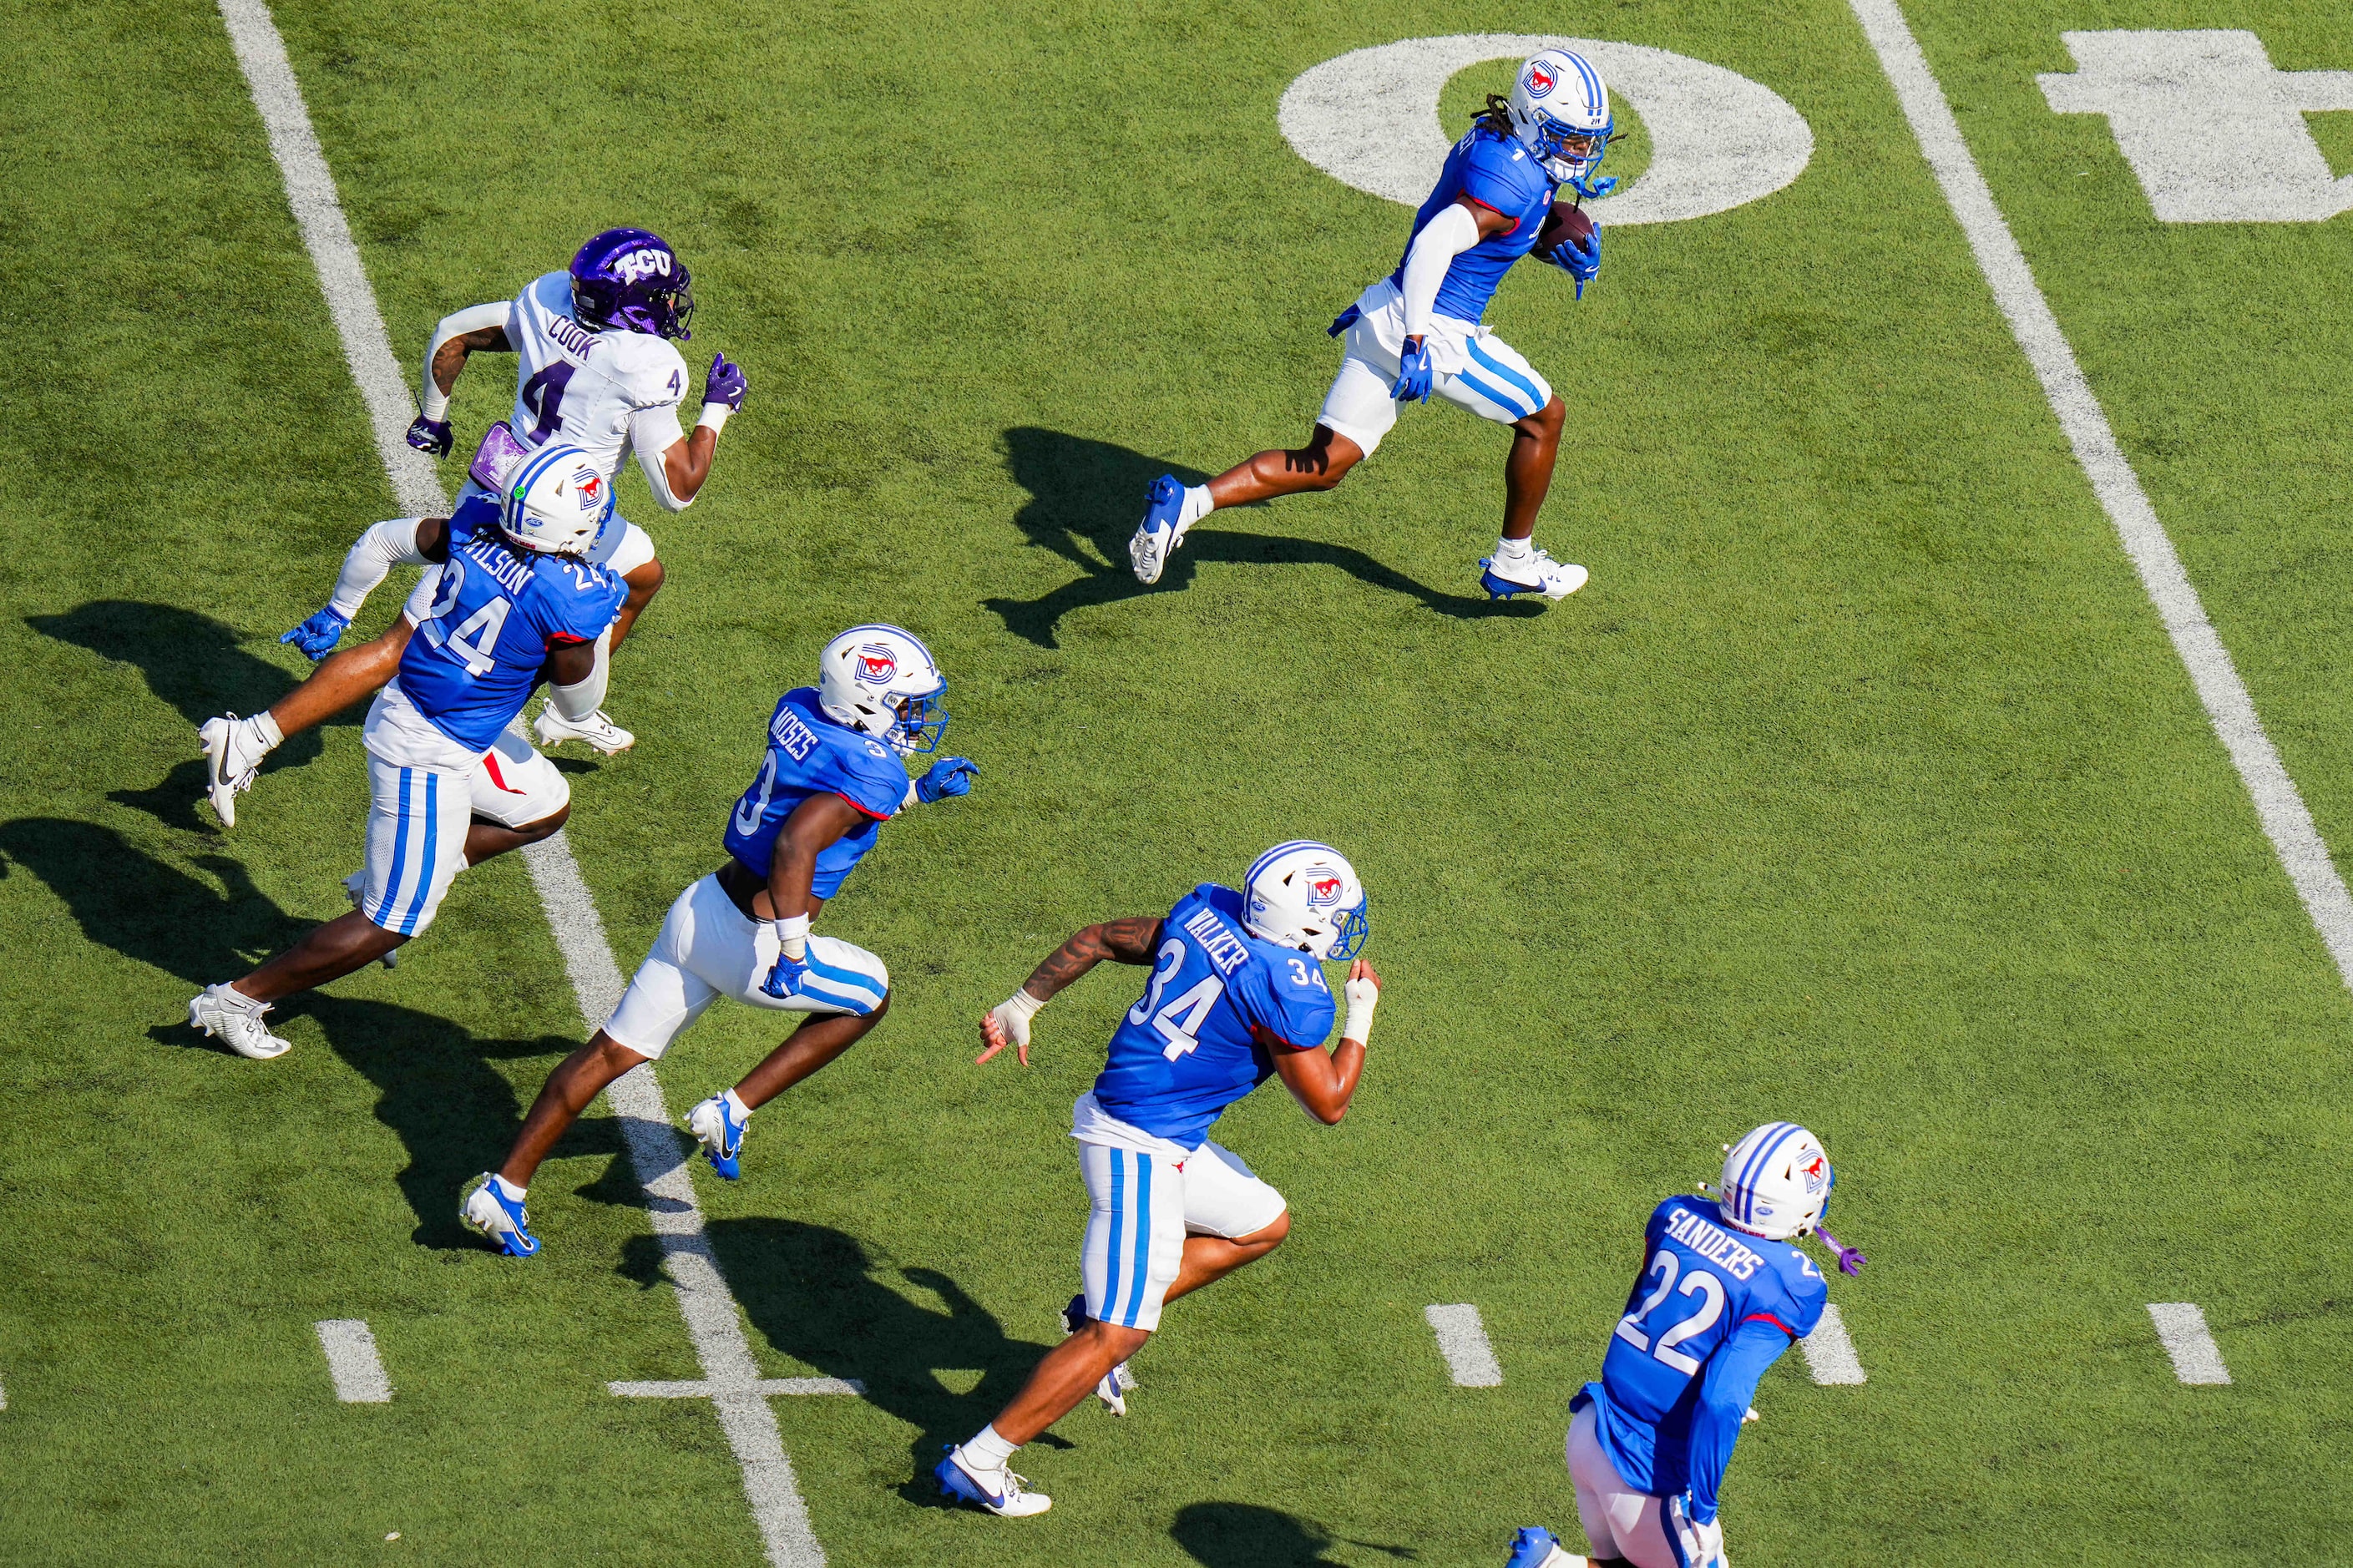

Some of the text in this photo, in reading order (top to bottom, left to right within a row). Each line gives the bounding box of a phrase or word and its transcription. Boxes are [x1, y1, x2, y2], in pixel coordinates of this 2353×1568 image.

[615, 249, 670, 286] TCU
[549, 316, 601, 361] COOK
[523, 359, 577, 446] 4
[667, 369, 681, 396] 4
[562, 564, 608, 591] 24
[420, 558, 512, 677] 24
[771, 707, 819, 761] MOSES
[863, 740, 887, 758] 3
[736, 749, 777, 837] 3
[1183, 908, 1249, 976] WALKER
[1129, 938, 1225, 1063] 34
[1288, 959, 1328, 994] 34
[1665, 1207, 1763, 1281] SANDERS
[1791, 1251, 1827, 1283] 2
[1615, 1250, 1726, 1377] 22
